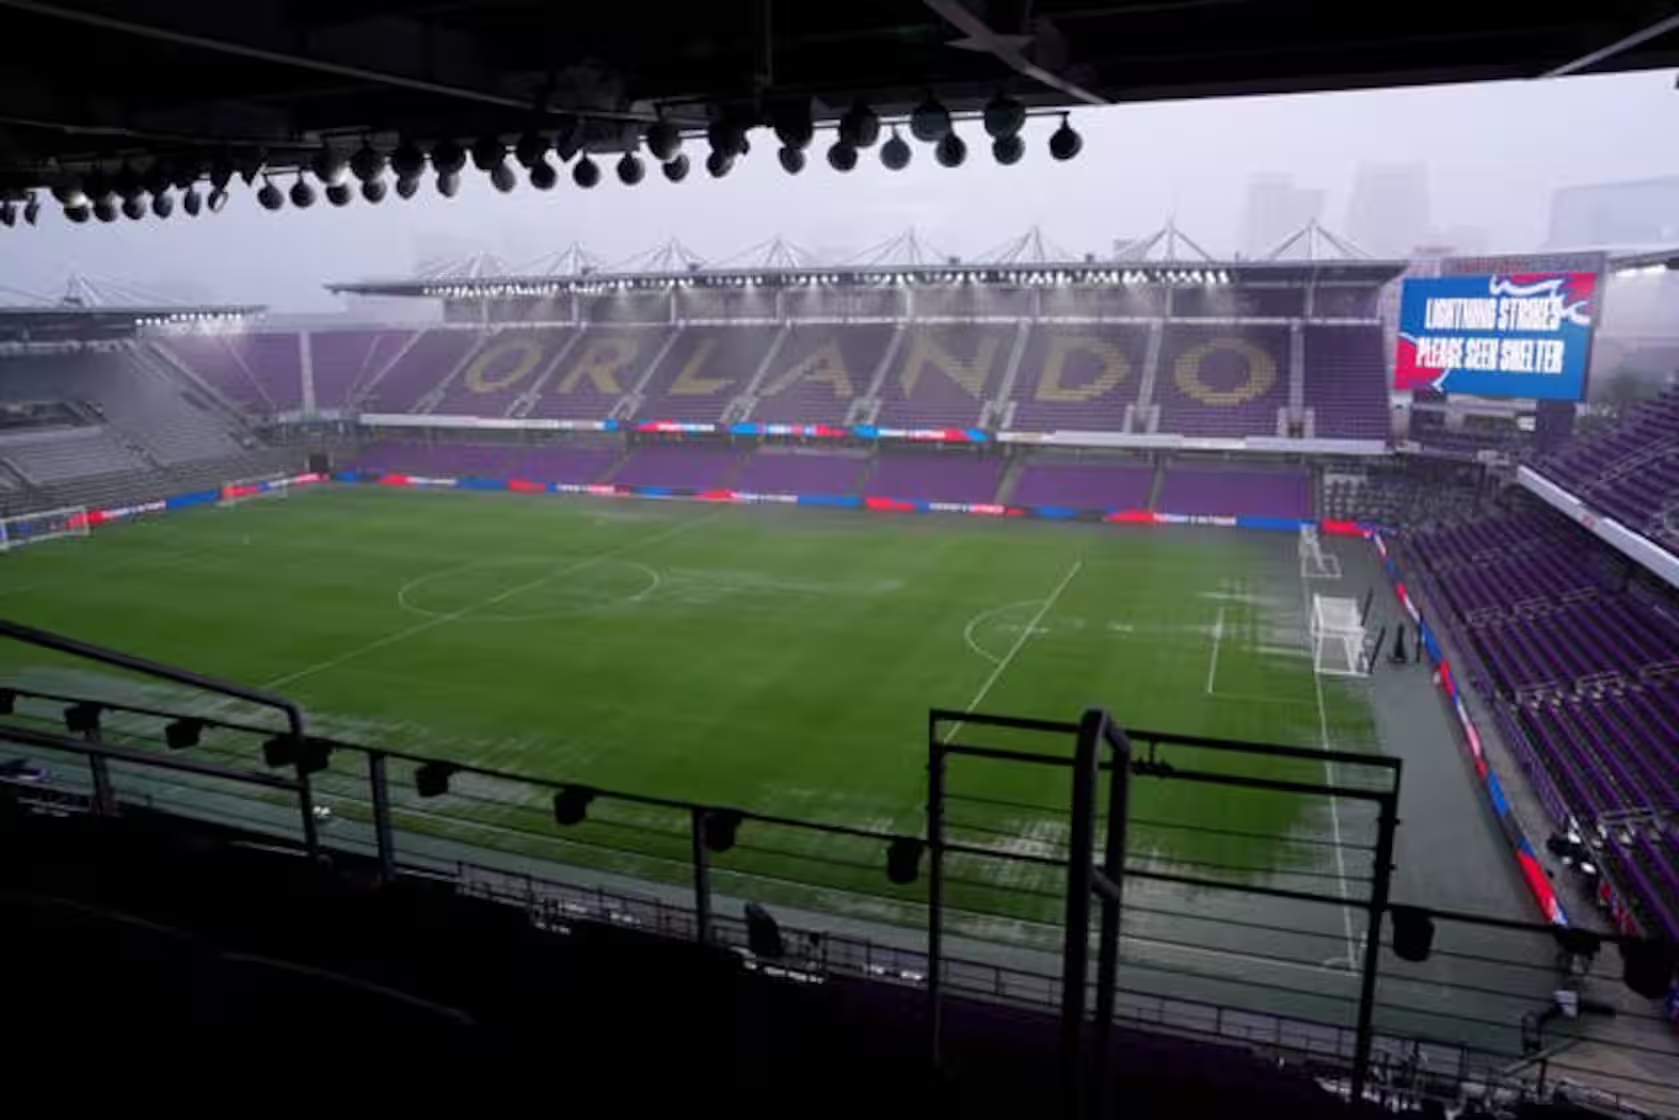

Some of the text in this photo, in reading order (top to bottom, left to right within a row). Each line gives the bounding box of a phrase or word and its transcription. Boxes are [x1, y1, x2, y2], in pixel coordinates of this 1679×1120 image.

[1425, 297, 1562, 332] LIGHTNING STRIKES
[463, 337, 1277, 405] ORLANDO
[1415, 336, 1565, 374] PLEASE SEEK SHELTER
